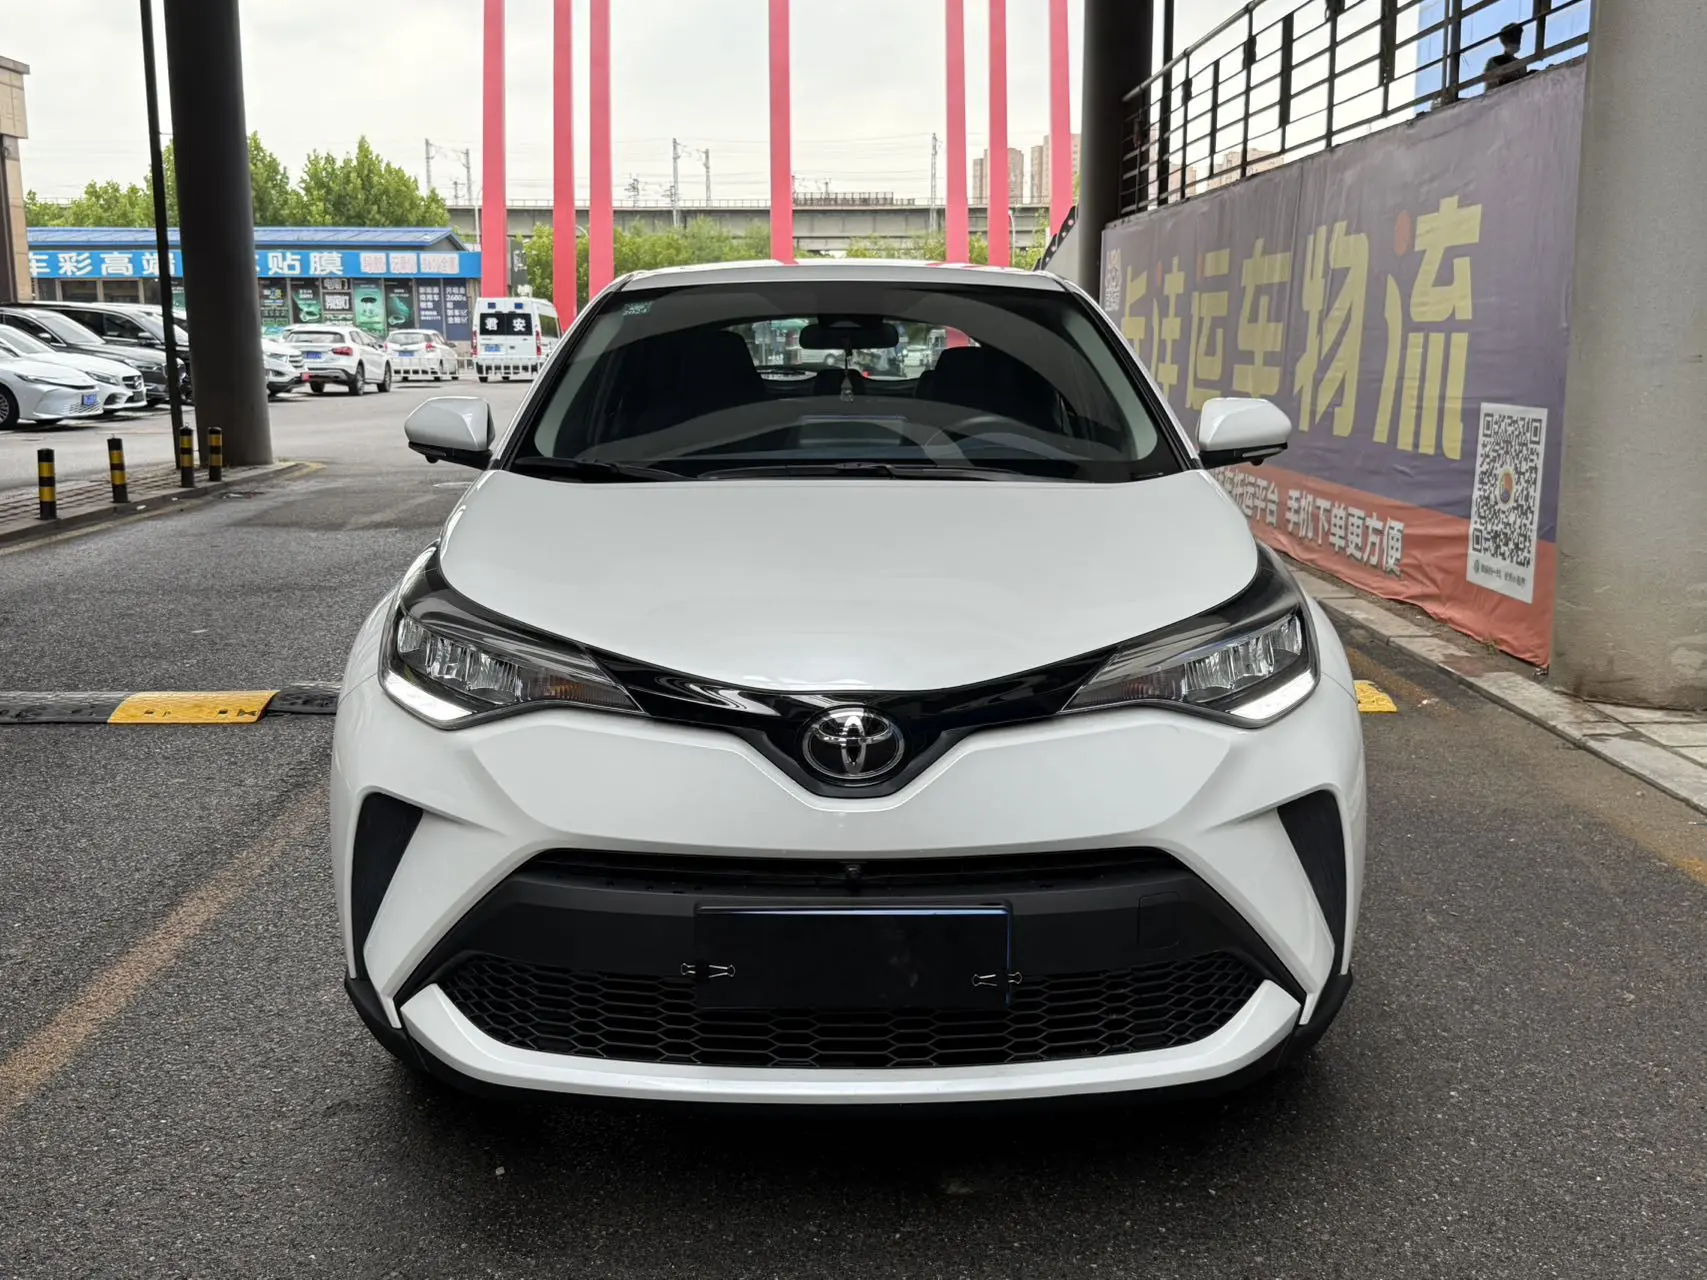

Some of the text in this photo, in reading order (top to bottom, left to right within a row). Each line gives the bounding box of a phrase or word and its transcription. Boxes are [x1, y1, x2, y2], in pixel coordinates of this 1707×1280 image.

[256, 251, 344, 275] 贴膜
[1285, 488, 1405, 578] 手机下单更方便
